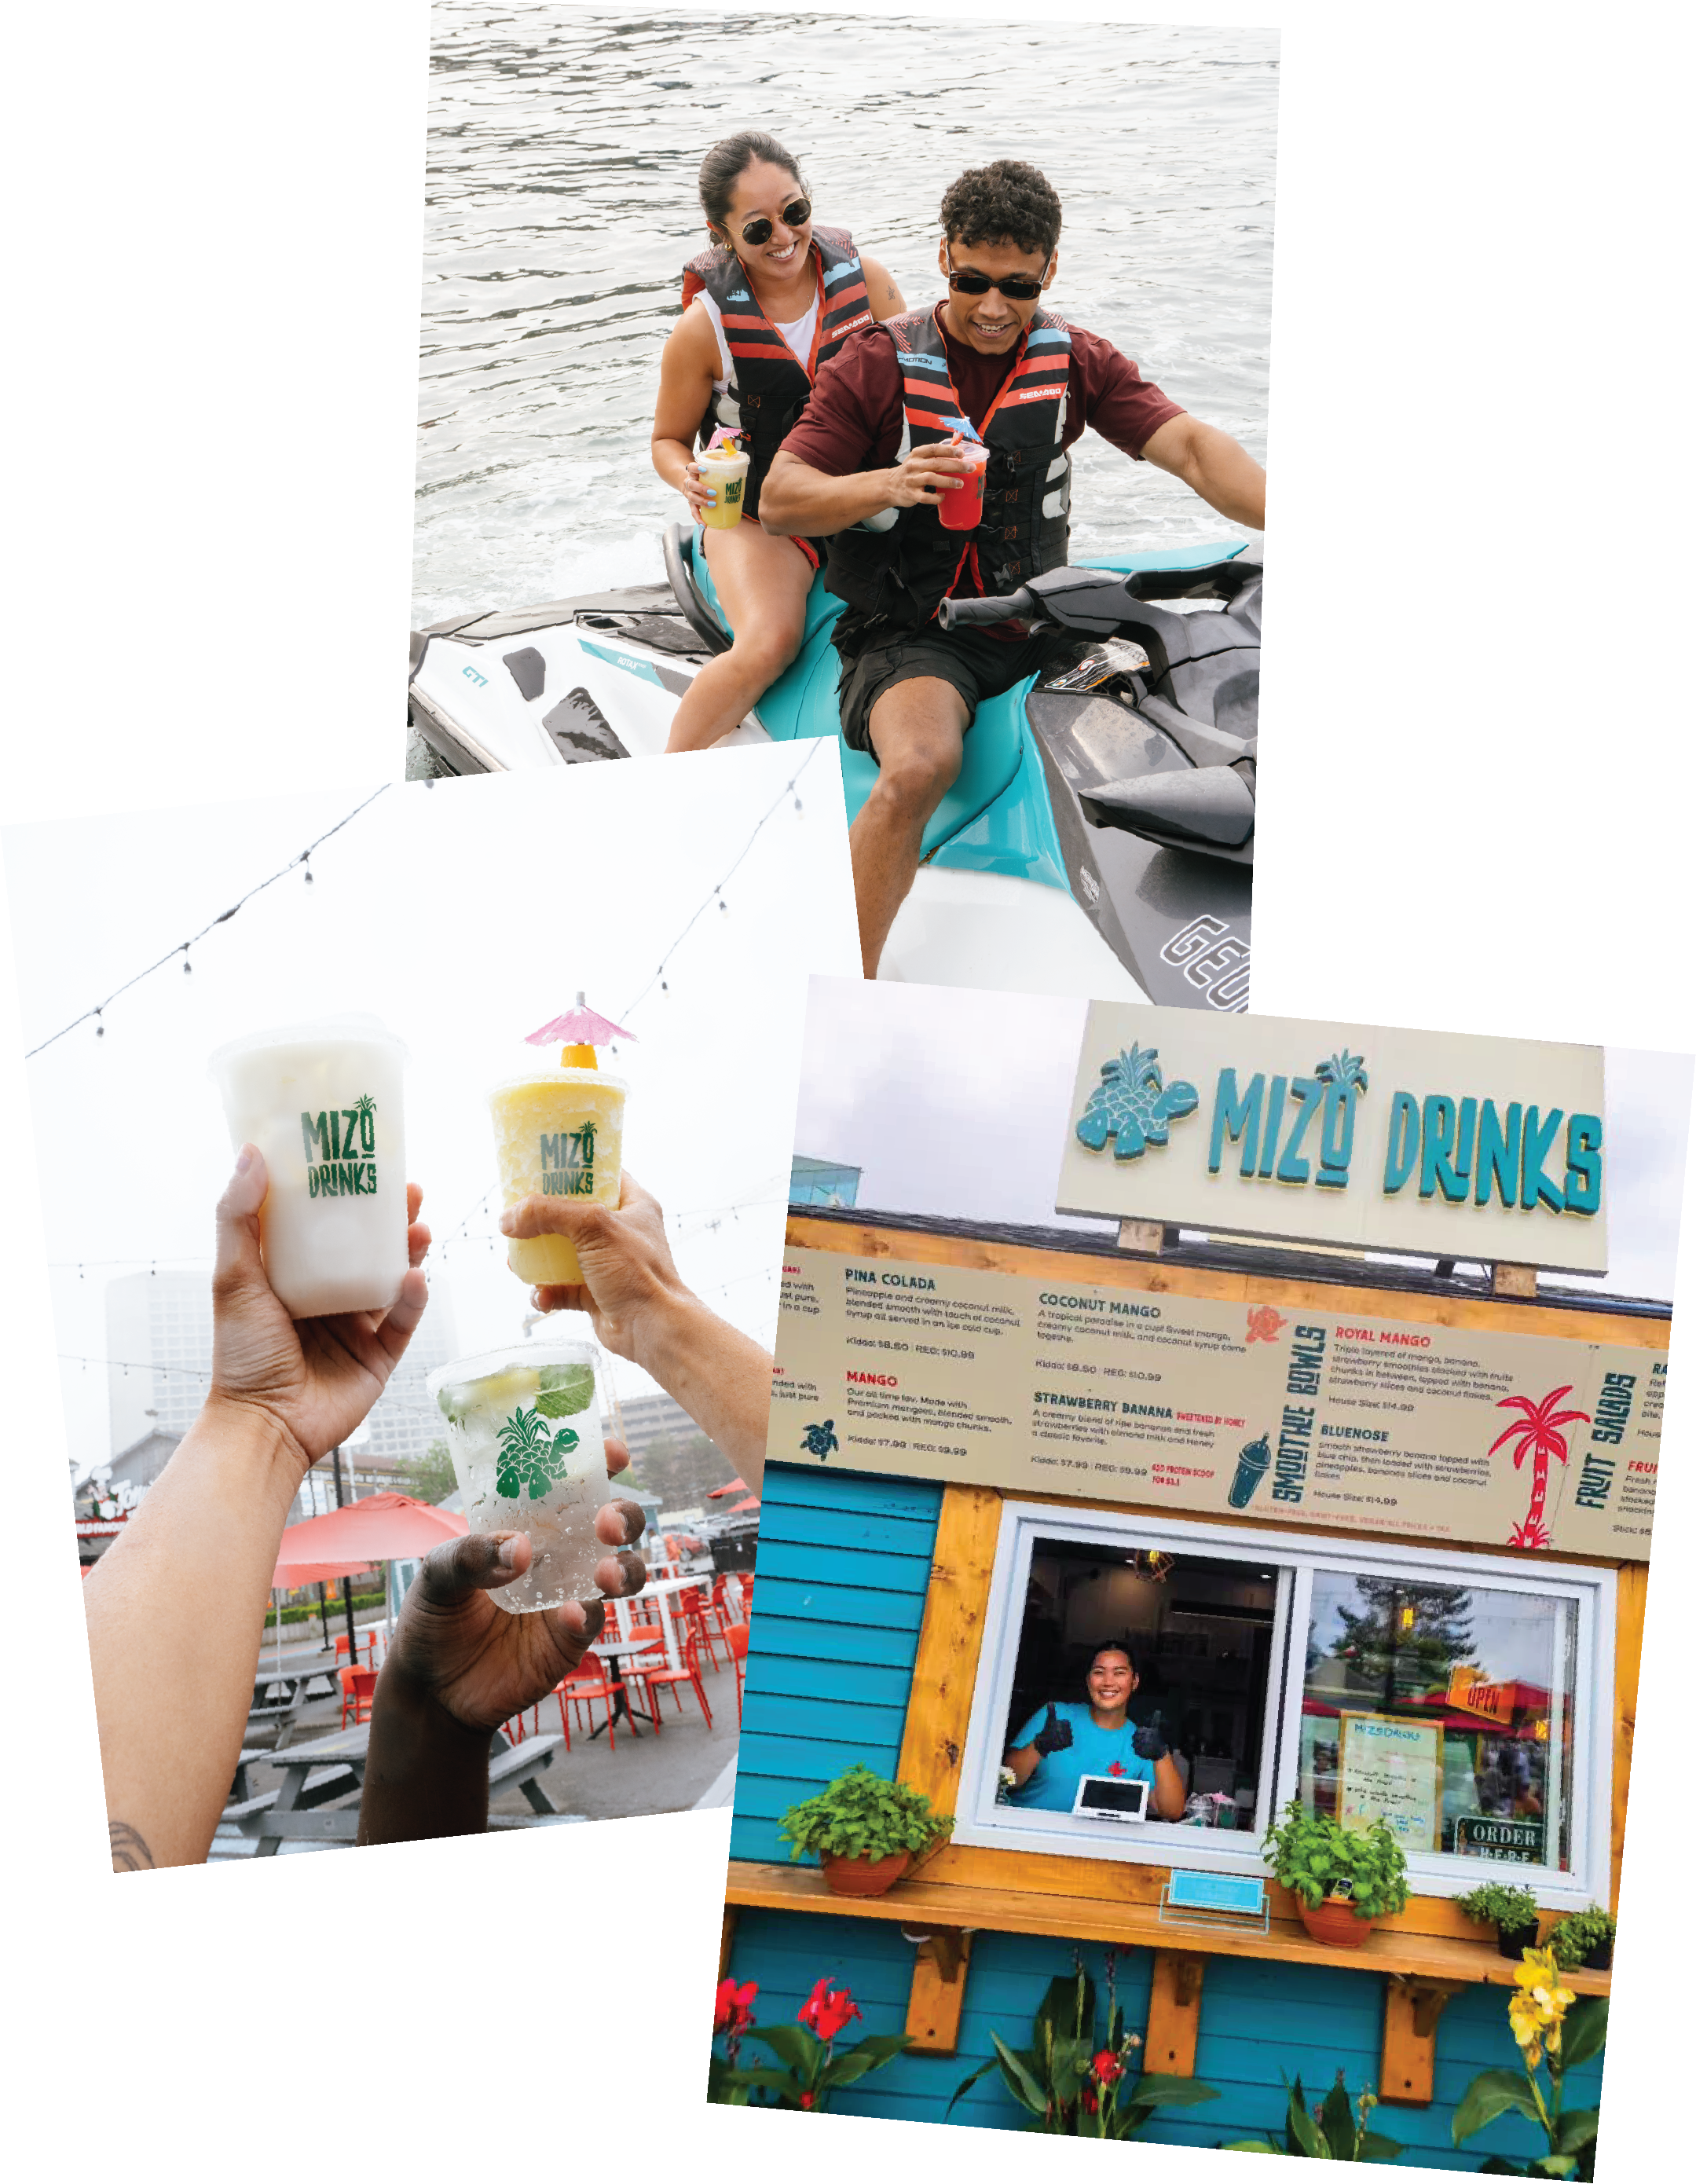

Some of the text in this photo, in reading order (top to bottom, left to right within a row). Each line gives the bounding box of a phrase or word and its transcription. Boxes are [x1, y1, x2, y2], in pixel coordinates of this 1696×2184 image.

[617, 656, 639, 670] ROTAX
[462, 665, 489, 688] GTI
[301, 1098, 377, 1163] MIZO
[1207, 1053, 1603, 1218] MIZO DRINKS
[540, 1125, 595, 1170] MIZO
[307, 1163, 377, 1198] DRINKS
[542, 1171, 594, 1196] DRINKS
[845, 1269, 936, 1290] PINA COLADA
[803, 1306, 819, 1314] cup
[846, 1299, 883, 1309] blended
[886, 1304, 920, 1314] smooth
[915, 1297, 950, 1307] creamy
[952, 1302, 988, 1311] coconut
[1039, 1293, 1161, 1318] COCONUT MANGO
[1038, 1321, 1071, 1332] creamy
[1075, 1326, 1109, 1336] coconut
[1157, 1336, 1192, 1346] coconut
[1195, 1342, 1219, 1350] syrup
[1335, 1327, 1430, 1347] ROYAL MANGO
[847, 1371, 897, 1387] MANGO
[848, 1398, 973, 1420] Premium blended
[921, 1397, 945, 1406] Made
[1034, 1391, 1118, 1412] STRAWBERRY
[1123, 1402, 1173, 1419] BANANA
[924, 1419, 954, 1428] mango
[1042, 1412, 1075, 1421] creamy
[1272, 1325, 1327, 1504] SMOOTHIE BOWLS
[1187, 1438, 1214, 1448] Honey
[1321, 1424, 1389, 1442] BLUENOSE
[1574, 1372, 1637, 1510] FRUIT SALADS
[1439, 1454, 1468, 1464] topped
[1467, 1685, 1500, 1714] OPEN
[1473, 1824, 1536, 1846] ORDER
